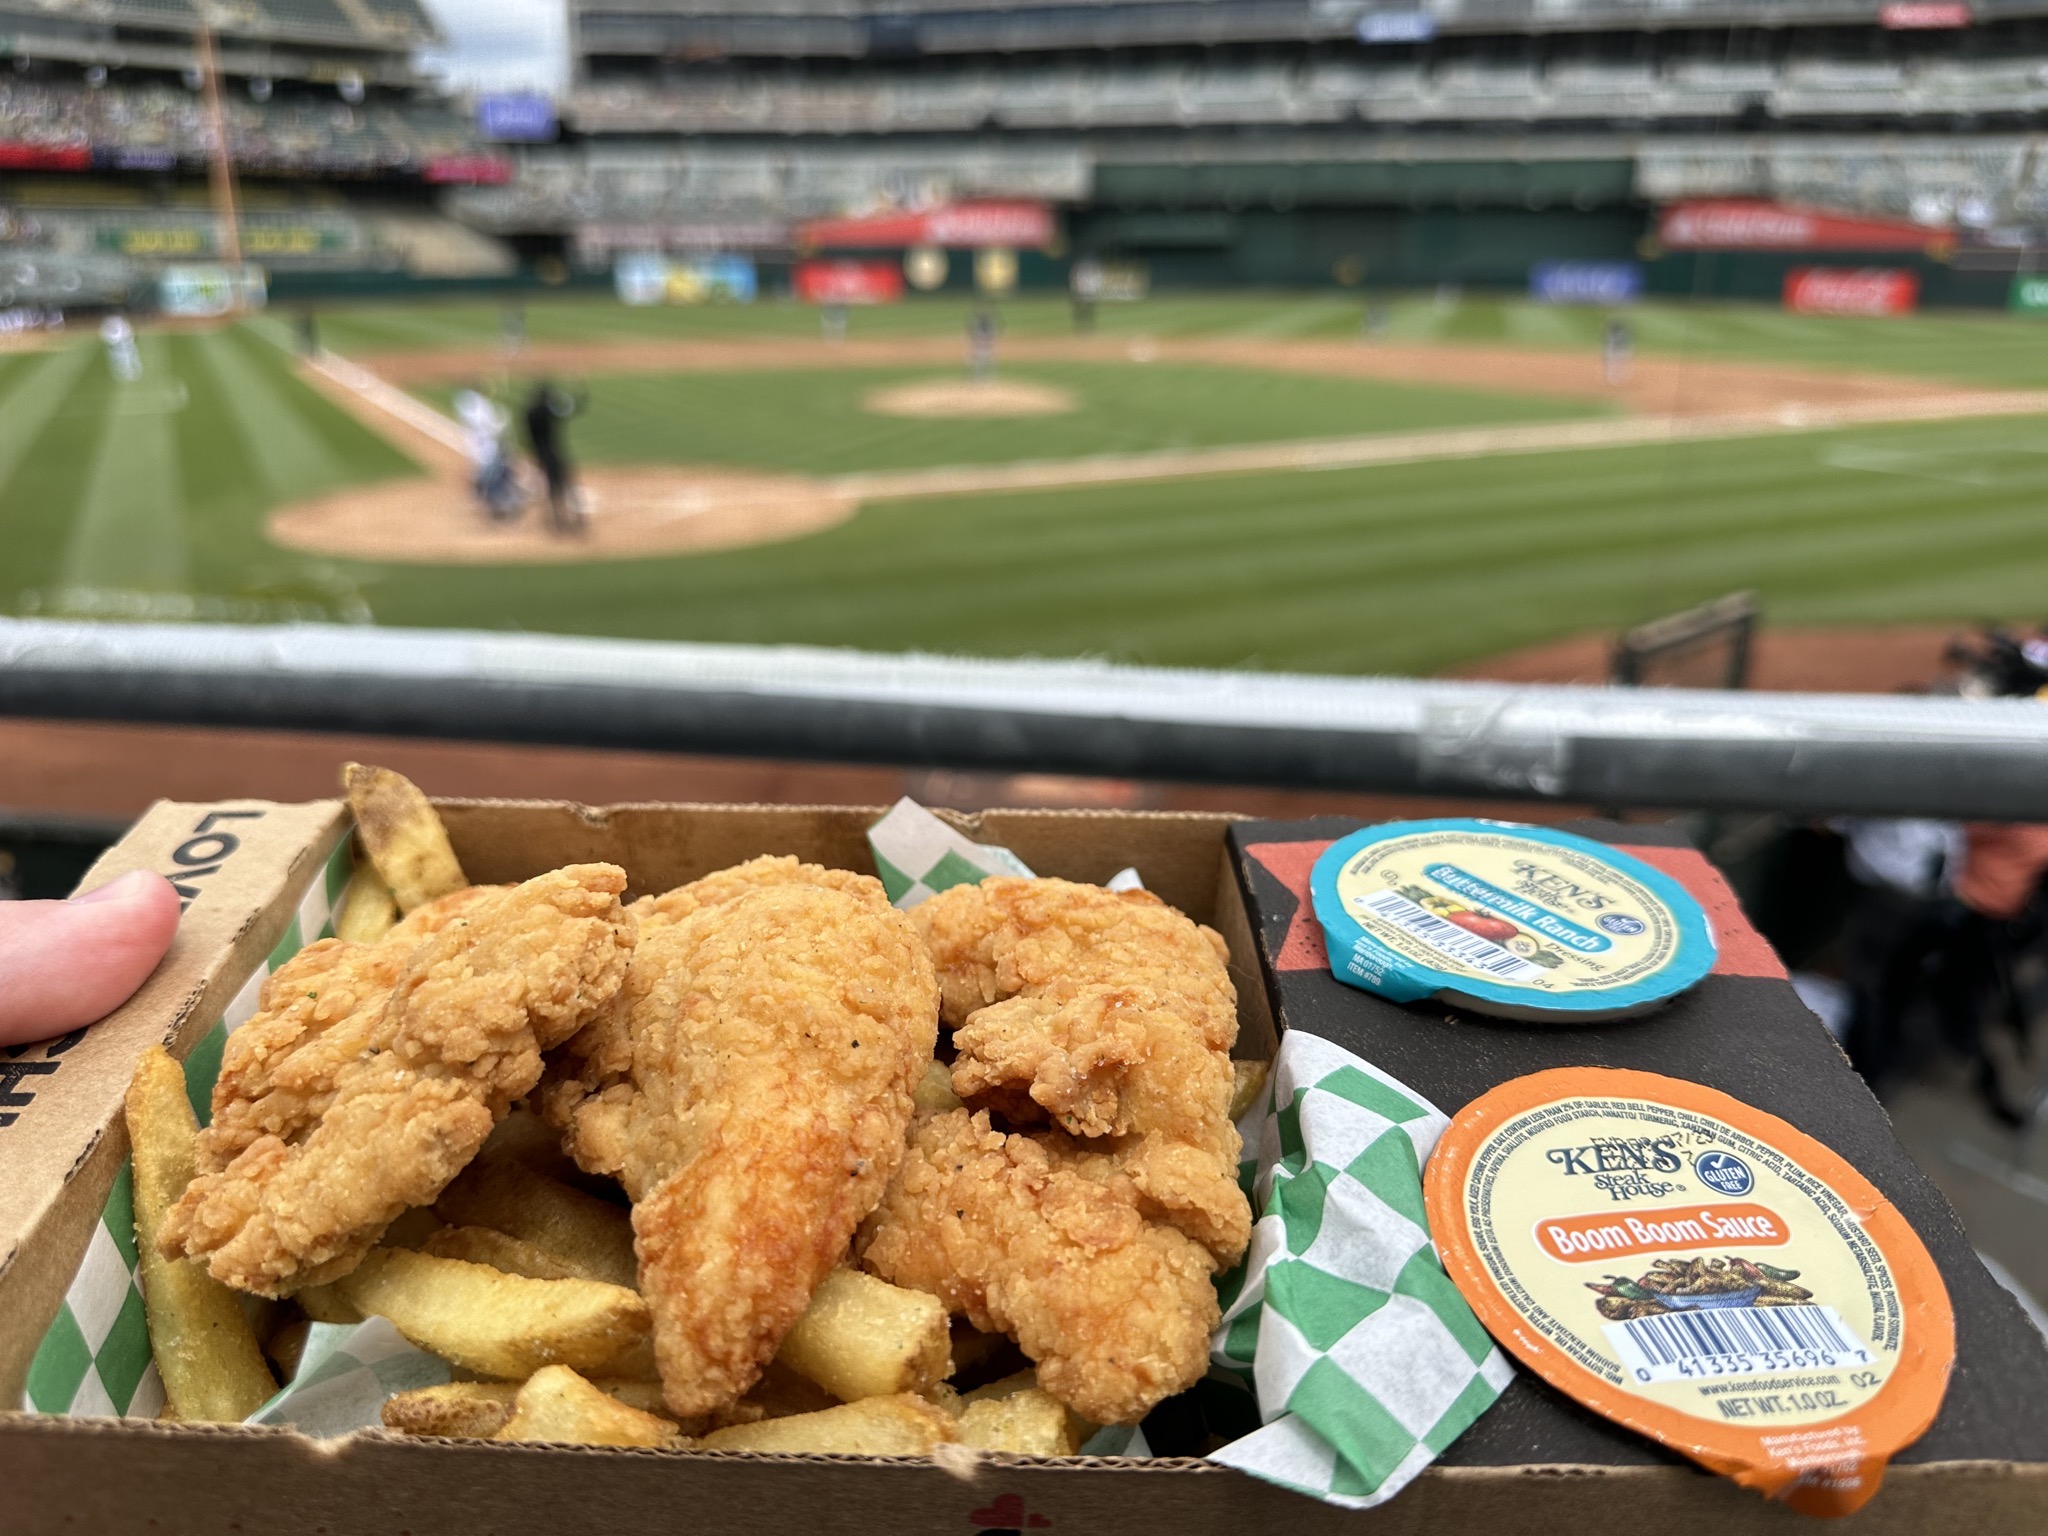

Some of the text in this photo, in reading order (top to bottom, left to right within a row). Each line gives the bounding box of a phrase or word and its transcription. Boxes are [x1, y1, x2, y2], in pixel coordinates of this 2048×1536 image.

[166, 811, 266, 913] LOV
[1431, 865, 1538, 920] Buttermilk
[1532, 913, 1599, 951] Ranch
[1363, 921, 1382, 932] NET
[1380, 930, 1397, 943] WT.
[1603, 916, 1637, 932] GLUTEN
[1352, 953, 1385, 977] MA 01752
[1543, 942, 1605, 971] Dressing
[1347, 961, 1382, 986] ITEM #789
[1533, 978, 1554, 989] 04
[1543, 1105, 1563, 1117] THAN
[1561, 1102, 1574, 1112] 2%
[1572, 1109, 1602, 1119] STARCH,
[1584, 1100, 1611, 1110] GARLIC,
[1602, 1110, 1637, 1120] ANNATTO/
[1611, 1101, 1626, 1110] RED
[1627, 1102, 1646, 1112] BELL
[1647, 1104, 1676, 1118] PEPPER,
[1504, 1116, 1532, 1138] CONTAINS
[1528, 1111, 1546, 1123] LESS
[1552, 1113, 1573, 1125] FOOD
[1638, 1112, 1680, 1128] TURMERIC,
[1699, 1118, 1719, 1132] CHILI
[1525, 1119, 1555, 1137] MODIFIED
[1720, 1126, 1731, 1136] DE
[1501, 1132, 1531, 1155] SHALLOTS,
[1718, 1136, 1736, 1150] GUM,
[1730, 1131, 1755, 1148] ARBOL
[1480, 1143, 1500, 1163] PEPPER,
[1545, 1140, 1682, 1175] KEN'S
[1737, 1145, 1764, 1162] CITRIC
[1755, 1144, 1785, 1166] PEPPER,
[1471, 1160, 1487, 1184] CAYENNE
[1488, 1153, 1509, 1176] PAPRIKA,
[1704, 1166, 1747, 1182] GLUTEN
[1762, 1159, 1782, 1176] ACID,
[1784, 1162, 1806, 1180] PLUM,
[1594, 1168, 1651, 1190] Steak
[1720, 1180, 1743, 1190] FREE
[1782, 1172, 1816, 1198] TARTARIC
[1804, 1177, 1823, 1191] RICE
[1468, 1184, 1480, 1200] AGED
[1480, 1174, 1498, 1218] PRESERVATIVES,
[1606, 1181, 1674, 1201] House
[1812, 1196, 1831, 1216] ACID,
[1820, 1187, 1849, 1218] VINEGAR,
[1547, 1211, 1778, 1255] Boom Boom Sauce
[1827, 1213, 1853, 1240] SODIUM
[1843, 1217, 1872, 1247] MUSTARD
[1490, 1244, 1514, 1276] DISODIUM
[1865, 1247, 1882, 1265] SEED,
[1875, 1265, 1893, 1290] SPICES,
[1499, 1281, 1530, 1314] DISTILLED
[1508, 1277, 1536, 1306] CALCIUM
[1532, 1305, 1551, 1320] AND
[1870, 1291, 1885, 1314] NATURAL
[1548, 1318, 1588, 1350] BENZOATE
[1554, 1332, 1569, 1347] OIL,
[1882, 1318, 1900, 1351] SORBATE,
[1565, 1345, 1604, 1375] SOYBEAN
[1585, 1347, 1621, 1373] SODIUM
[1636, 1367, 1652, 1382] 0
[1678, 1353, 1753, 1377] 41335
[1758, 1349, 1836, 1369] 35696
[1604, 1369, 1623, 1386] ING:
[1698, 1374, 1841, 1396] www.kensfoodservice.com
[1849, 1371, 1882, 1388] 02
[1717, 1389, 1849, 1418] NET WT. 1.0 OZ.
[1760, 1425, 1859, 1446] Manufactured by
[1768, 1444, 1802, 1457] Ken's
[1843, 1436, 1867, 1447] Inc.
